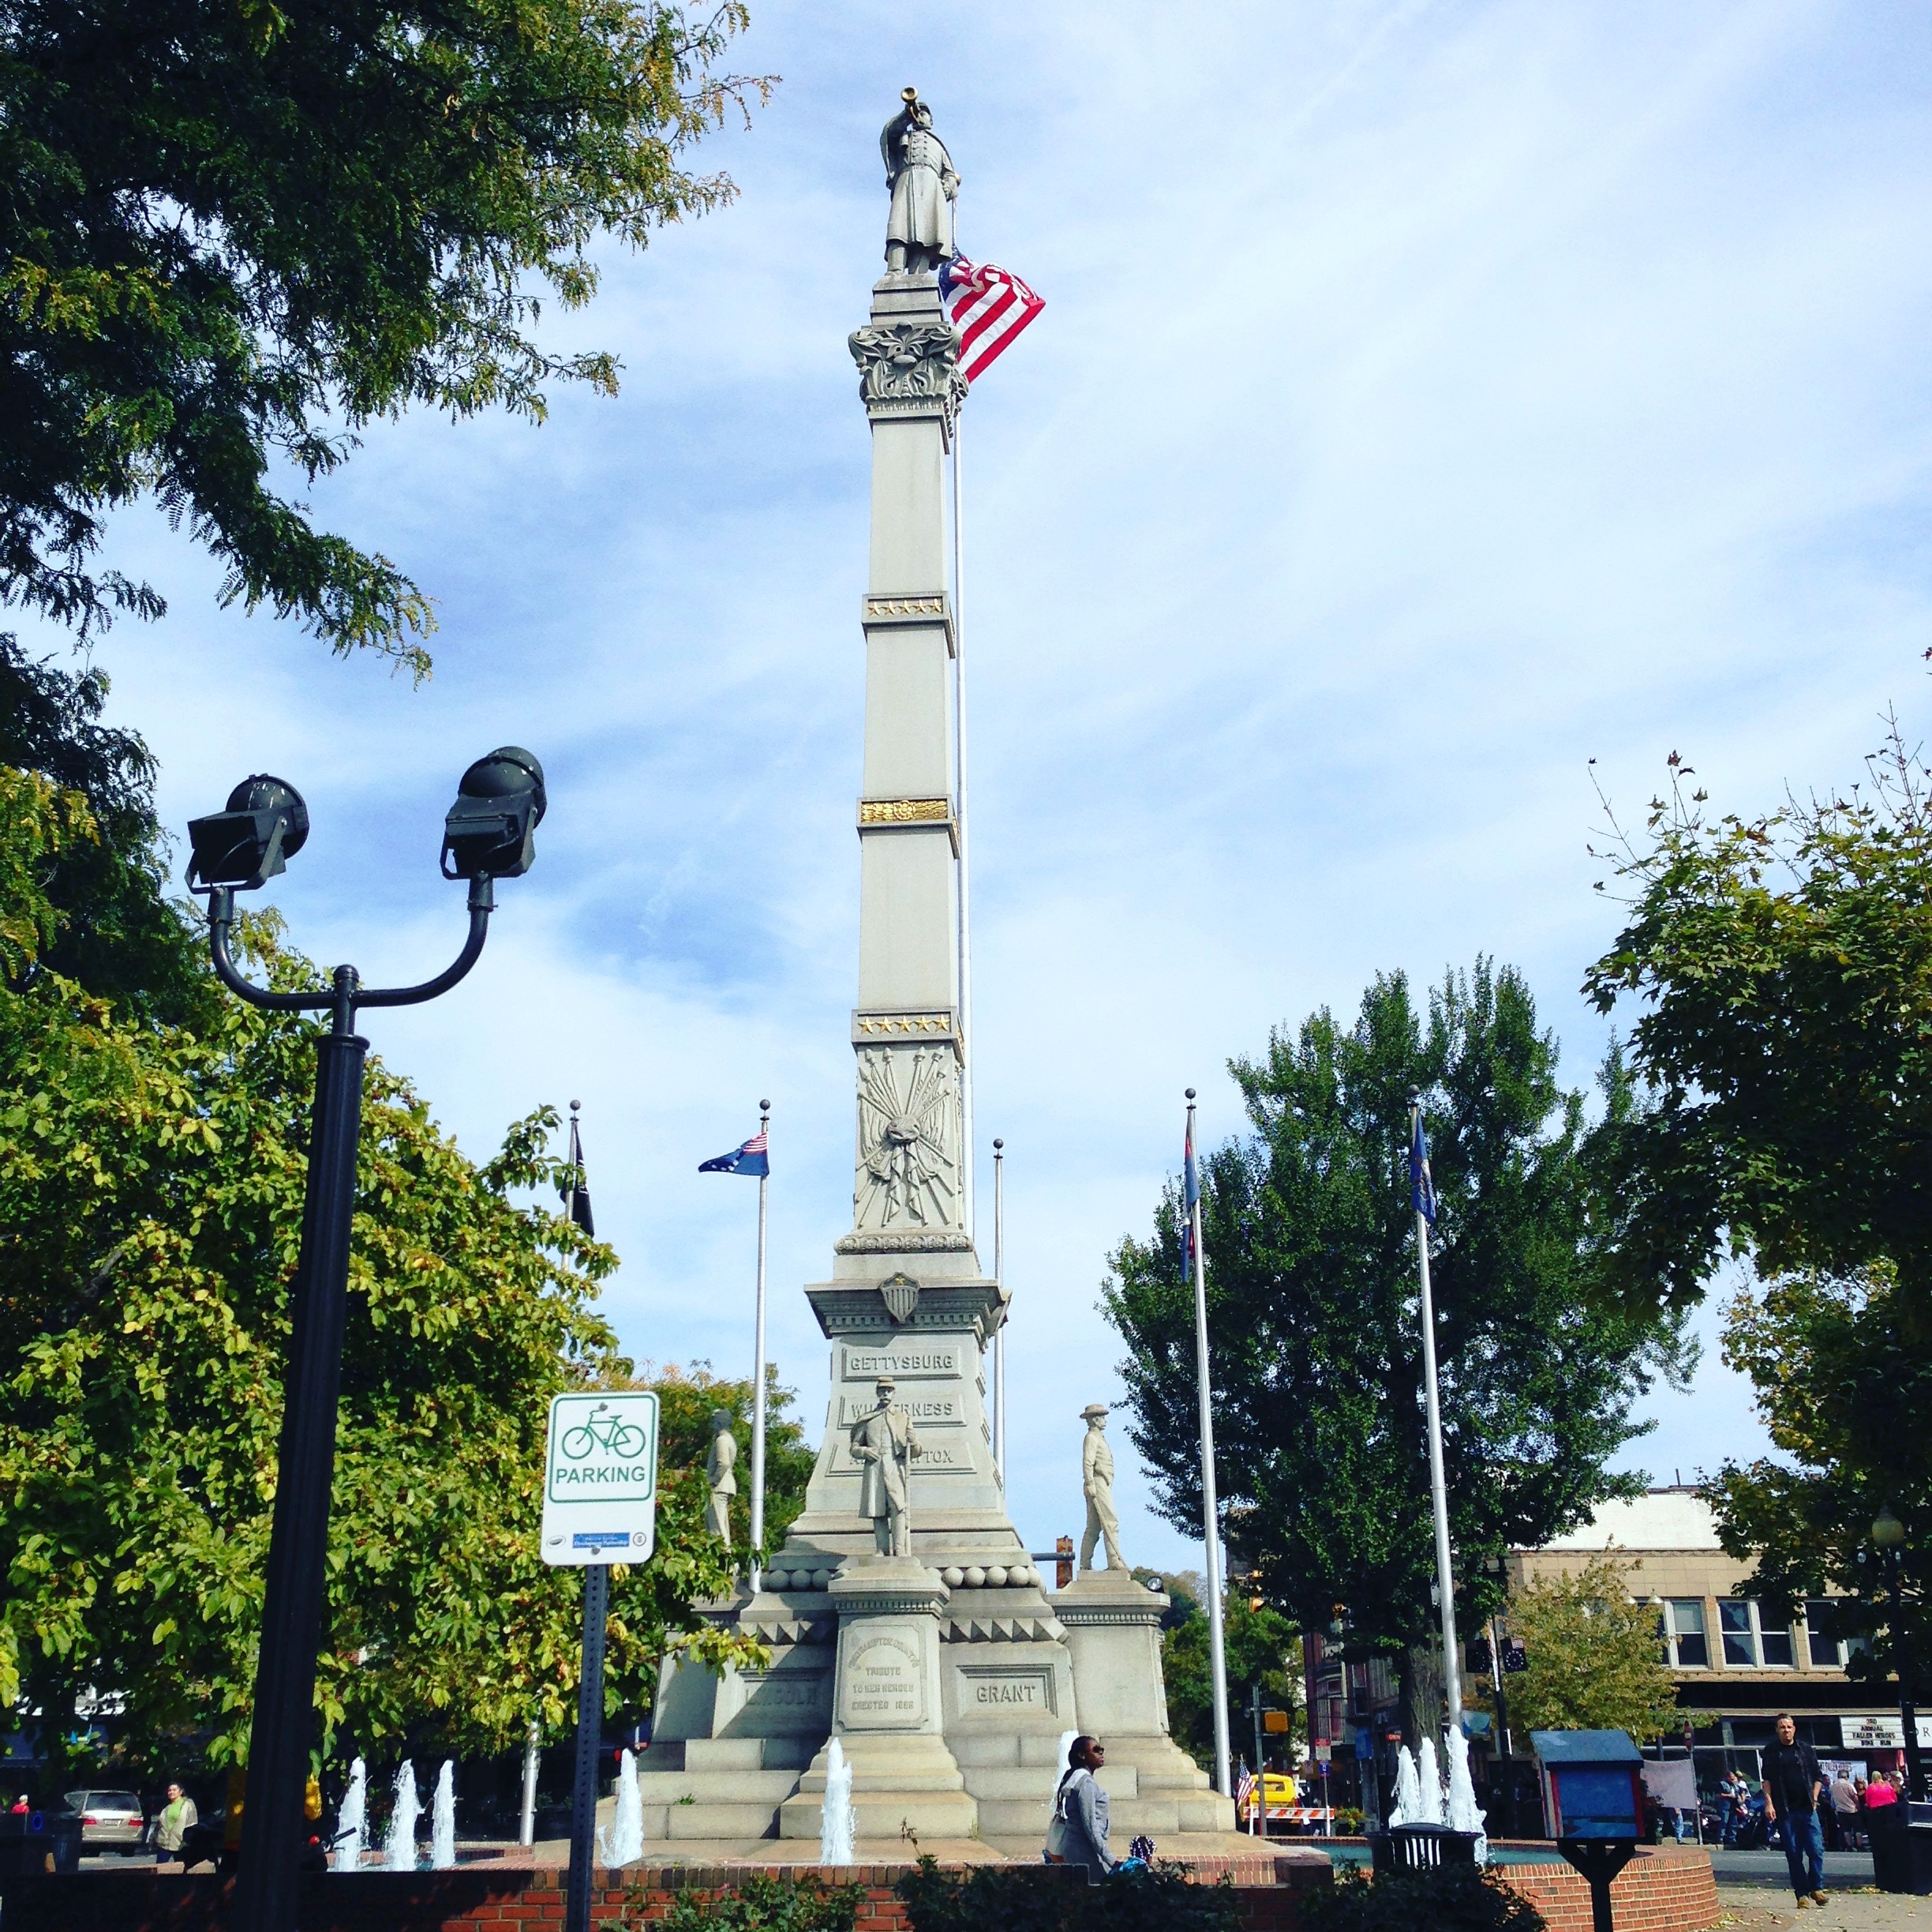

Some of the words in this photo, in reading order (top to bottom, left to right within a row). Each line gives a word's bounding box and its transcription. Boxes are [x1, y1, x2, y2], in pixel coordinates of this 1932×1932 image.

[851, 1354, 953, 1370] GETTYSBURG
[556, 1466, 646, 1484] PARKING
[976, 1685, 1035, 1703] GRANT
